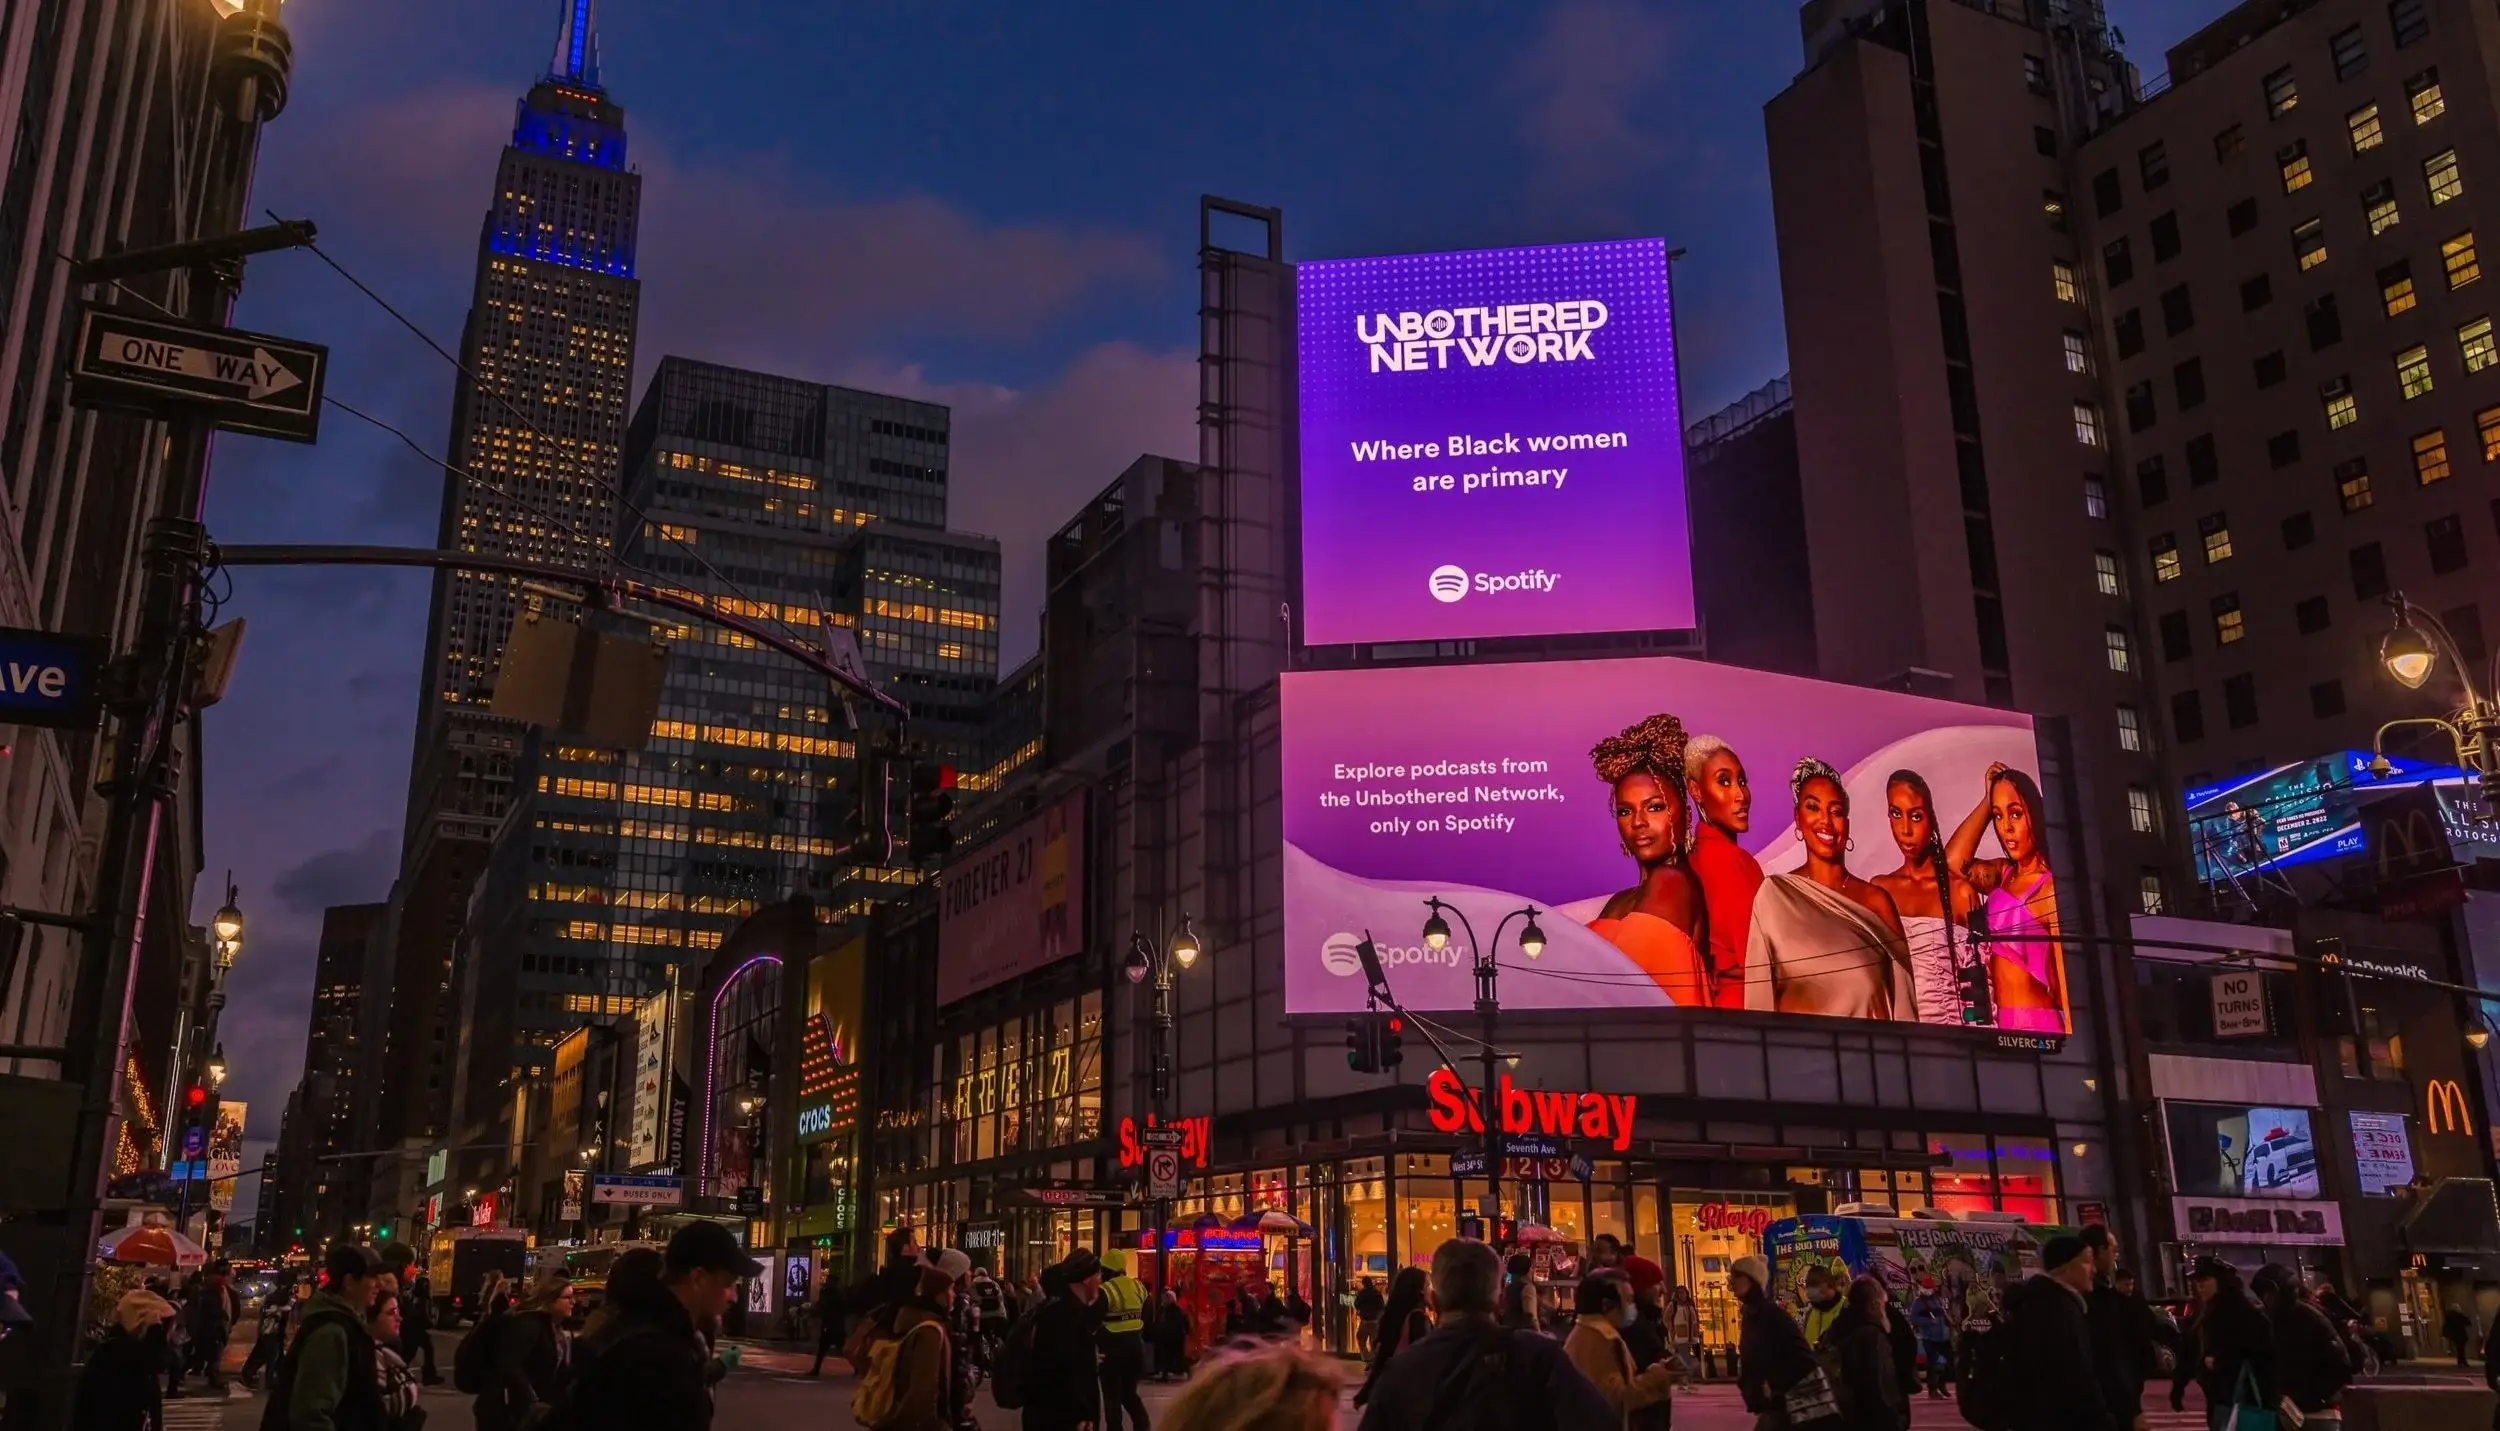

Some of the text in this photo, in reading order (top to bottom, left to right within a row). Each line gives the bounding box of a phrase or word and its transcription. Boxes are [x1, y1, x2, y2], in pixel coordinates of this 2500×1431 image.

[1356, 300, 1609, 344] UNBOTHERED
[122, 338, 282, 388] ONE WAY
[1370, 329, 1596, 374] NETWORK
[1351, 431, 1628, 462] Where Black women
[1412, 465, 1569, 494] are primary
[1474, 569, 1557, 595] Spotify
[0, 662, 66, 698] ve
[1333, 757, 1548, 783] Explore podcasts from
[1319, 783, 1566, 807] the Unbothered Network,
[1369, 812, 1516, 836] only on Spotify
[2337, 836, 2360, 848] PLAY
[945, 835, 1034, 921] FOREVER 21
[2346, 957, 2430, 981] cDonald's
[2224, 978, 2249, 996] NO
[2216, 998, 2260, 1015] TURNS
[799, 1103, 831, 1136] crocs
[670, 1097, 687, 1170] OLD NAVY
[1505, 1142, 1557, 1155] Seventh Ave
[1452, 1161, 1467, 1173] West
[1477, 1159, 1485, 1170] St
[1519, 1156, 1532, 1176] 2
[1547, 1157, 1563, 1177] 3
[623, 1190, 673, 1200] BUSES ONLY
[965, 1230, 991, 1249] FOREVER
[1775, 1238, 1841, 1256] THE BUD TOUR
[1895, 1229, 1930, 1248] THE
